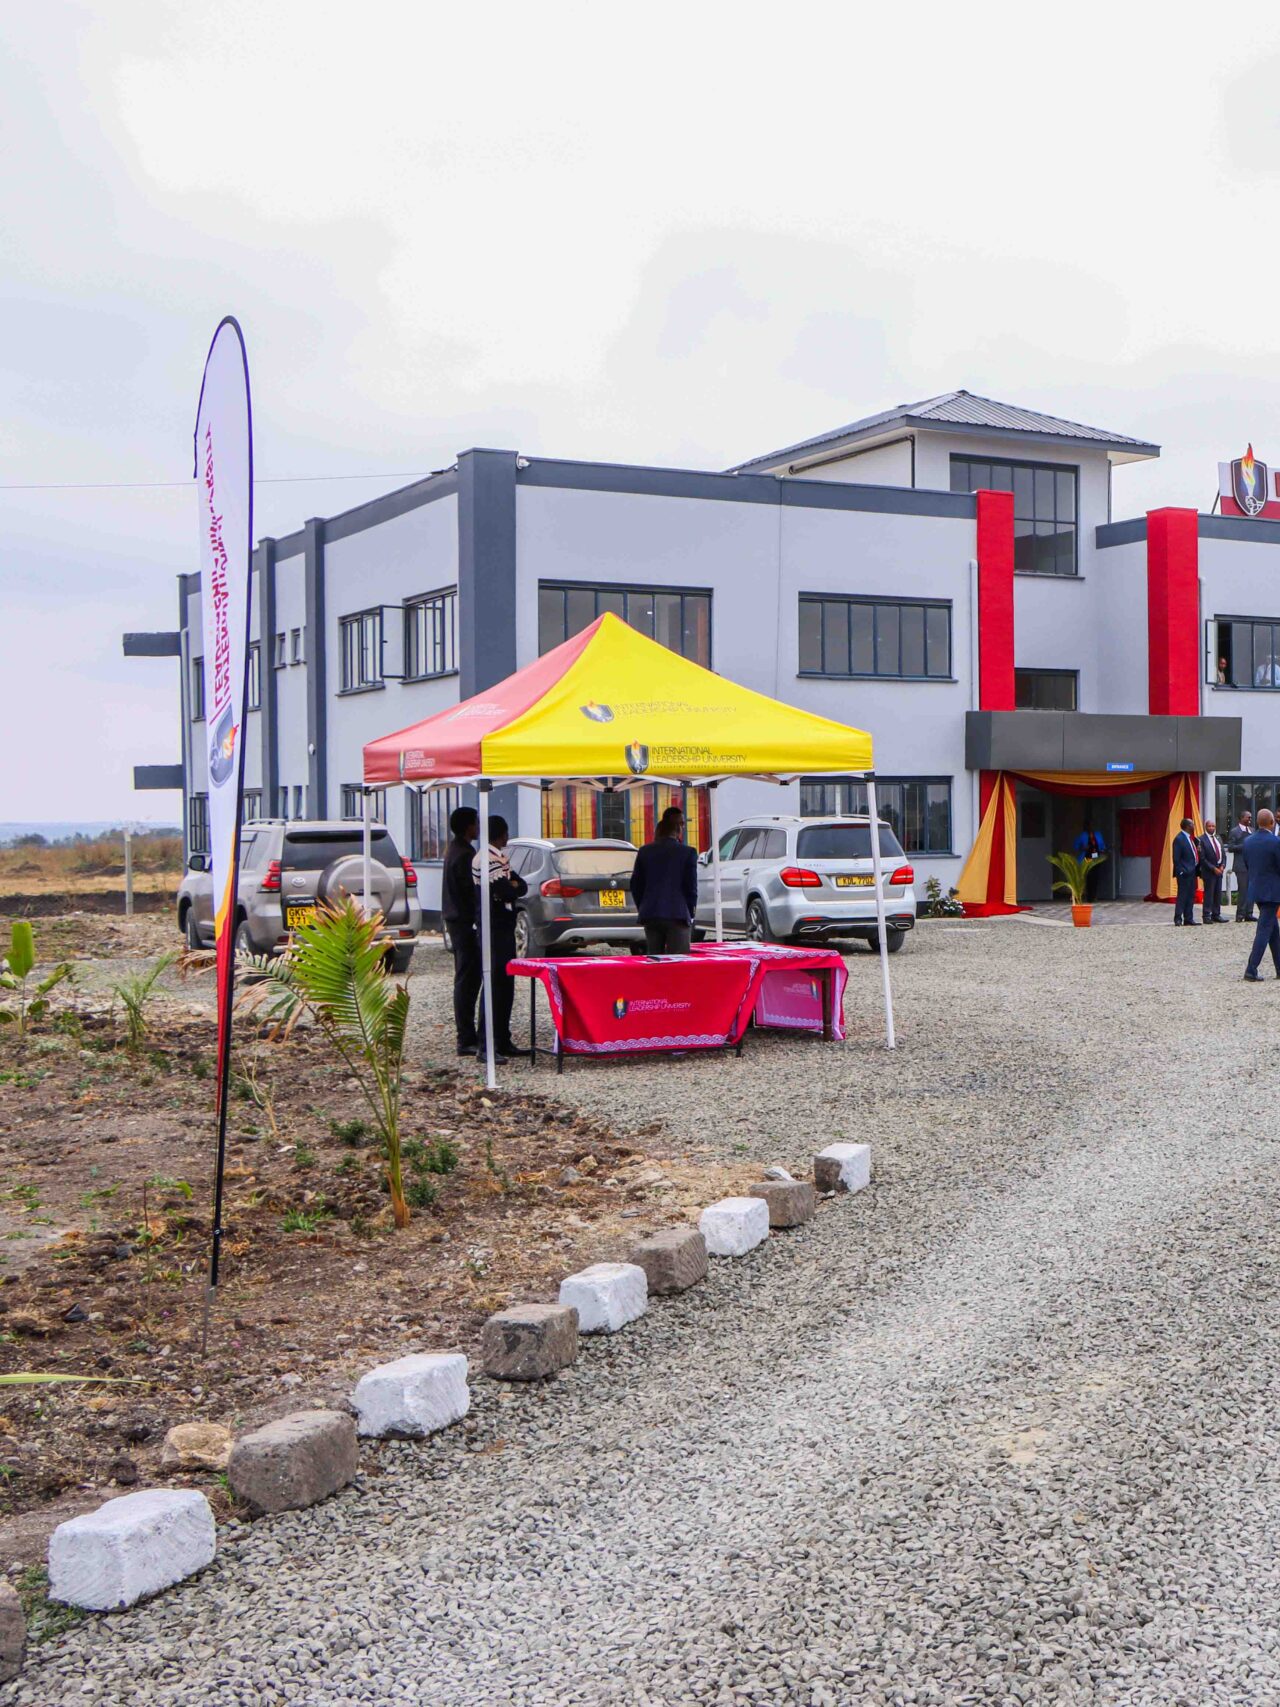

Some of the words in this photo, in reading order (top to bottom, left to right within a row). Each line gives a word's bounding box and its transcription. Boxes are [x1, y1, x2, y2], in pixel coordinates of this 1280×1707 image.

[651, 746, 713, 755] INTERNATIONAL
[651, 755, 701, 764] LEADERSHIP
[703, 755, 748, 763] UNIVERSITY
